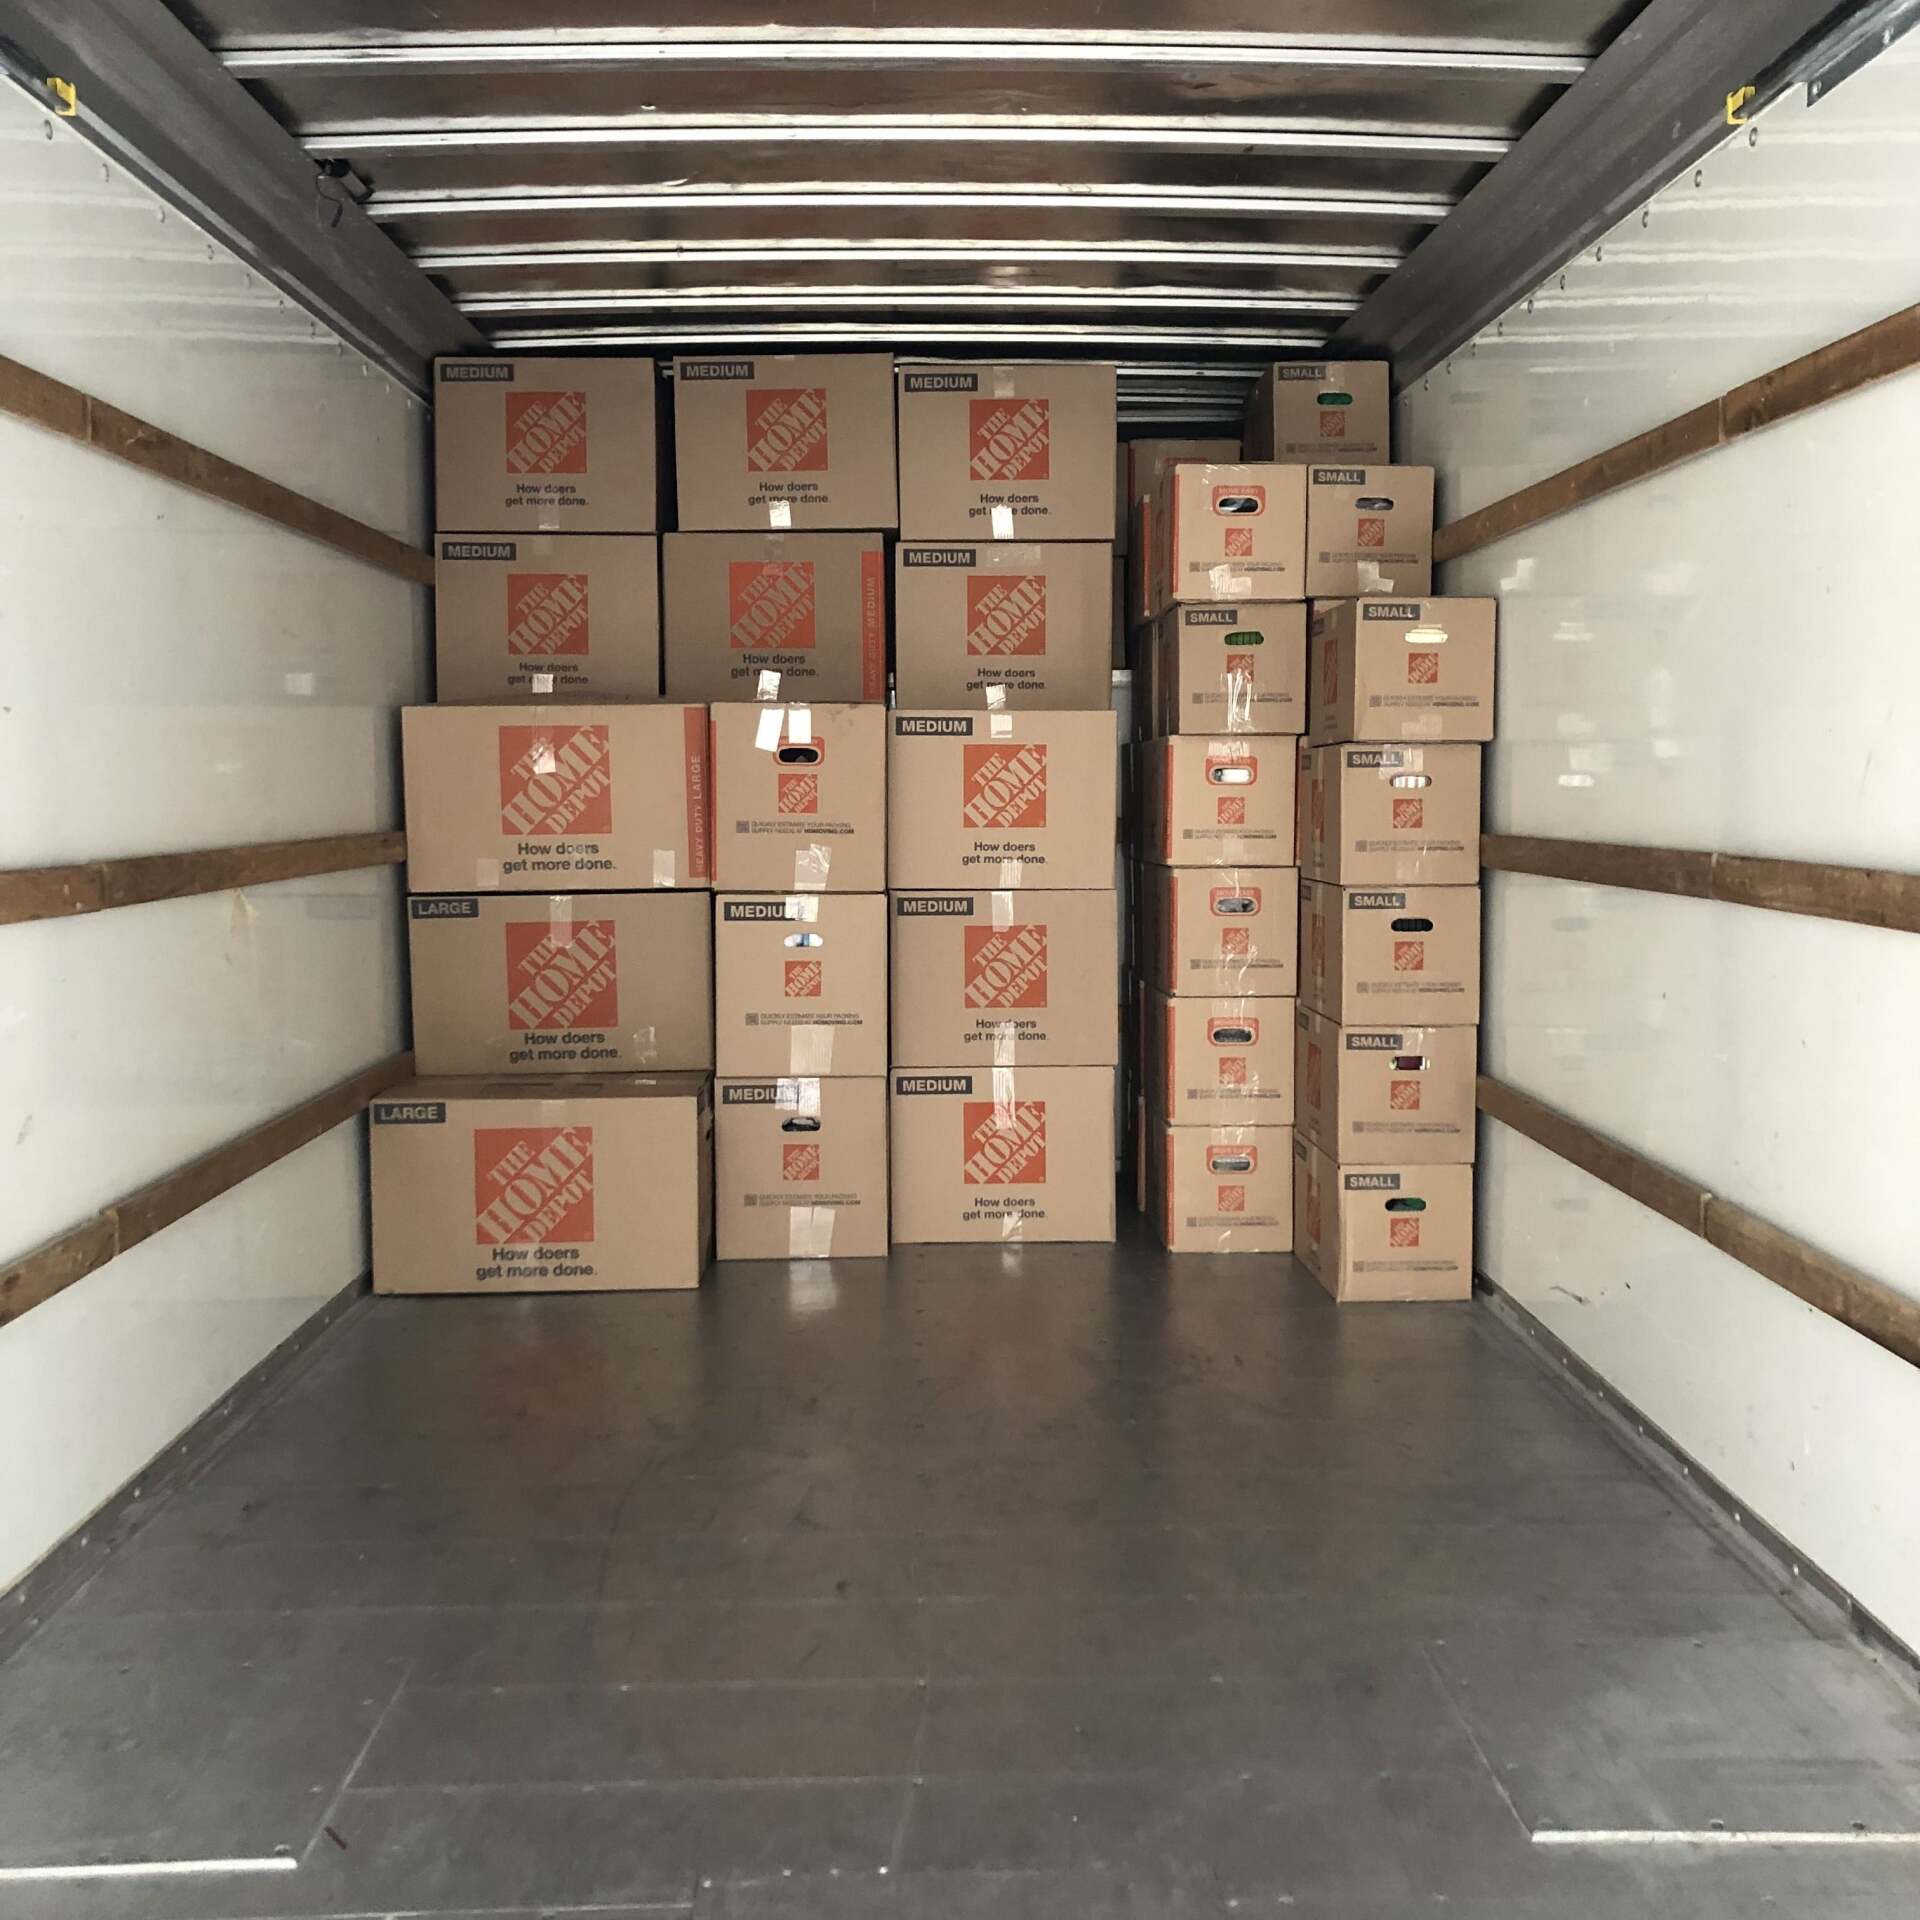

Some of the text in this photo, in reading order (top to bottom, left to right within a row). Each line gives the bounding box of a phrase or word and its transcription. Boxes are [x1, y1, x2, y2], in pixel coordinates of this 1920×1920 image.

[446, 367, 508, 379] MEDIUM
[686, 365, 748, 377] MEDIUM
[1283, 369, 1322, 378] SMALL
[910, 377, 972, 388] MEDIUM
[513, 400, 546, 433] THE
[754, 397, 787, 430] THE
[747, 389, 827, 471] HOME
[977, 407, 1010, 440] THE
[506, 393, 585, 473] HOME
[970, 400, 1048, 479] HOME
[538, 422, 585, 472] DEPOT
[779, 420, 827, 471] DEPOT
[1001, 430, 1048, 479] DEPOT
[1318, 472, 1360, 483] SMALL
[517, 484, 576, 494] How doers
[760, 482, 818, 492] How doers
[506, 498, 523, 507] get
[749, 495, 766, 505] get
[981, 494, 1038, 503] How doers
[969, 506, 987, 517] get
[448, 546, 510, 557] MEDIUM
[909, 552, 970, 564] MEDIUM
[515, 582, 549, 615] THE
[730, 562, 815, 648] HOME
[867, 577, 876, 626] MEDIUM
[974, 583, 1007, 616] THE
[508, 575, 588, 654] HOME
[967, 576, 1045, 655] HOME
[1190, 613, 1233, 623] SMALL
[1368, 607, 1415, 618] SMALL
[764, 594, 815, 648] DEPOT
[540, 605, 588, 654] DEPOT
[998, 605, 1045, 654] DEPOT
[743, 654, 805, 664] How doers
[520, 663, 578, 672] How doers
[731, 667, 750, 678] get
[978, 668, 1036, 678] How doers
[508, 675, 525, 685] get
[967, 679, 984, 691] get
[902, 720, 967, 732] MEDIUM
[1352, 754, 1399, 764] SMALL
[692, 754, 702, 799] LARGE
[972, 753, 1005, 786] THE
[500, 726, 610, 834] HOME
[964, 745, 1046, 827] HOME
[544, 766, 610, 833] DEPOT
[997, 776, 1046, 827] DEPOT
[518, 842, 599, 854] How doers
[974, 842, 1036, 852] How doers
[503, 859, 616, 874] get more done.
[962, 855, 980, 866] get
[904, 900, 968, 912] MEDIUM
[1354, 896, 1400, 906] SMALL
[418, 902, 472, 915] LARGE
[730, 905, 796, 917] MEDIU
[973, 934, 1006, 967] THE
[965, 926, 1046, 1008] HOME
[507, 921, 616, 1029] HOME
[998, 956, 1046, 1007] DEPOT
[551, 961, 616, 1028] DEPOT
[525, 1032, 605, 1044] How doers
[964, 1032, 982, 1043] get
[1351, 1037, 1398, 1047] SMALL
[510, 1050, 534, 1064] get
[539, 1048, 576, 1060] more
[903, 1079, 967, 1092] MEDIUM
[381, 1106, 438, 1120] LARGE
[964, 1102, 1045, 1183] HOME
[486, 1139, 535, 1186] THE
[997, 1133, 1045, 1183] DEPOT
[476, 1128, 592, 1243] HOME
[1350, 1177, 1395, 1187] SMALL
[522, 1171, 592, 1242] DEPOT
[975, 1197, 1035, 1207] How doers
[963, 1210, 981, 1221] get
[492, 1247, 579, 1261] How doers
[476, 1263, 597, 1280] get more done.
